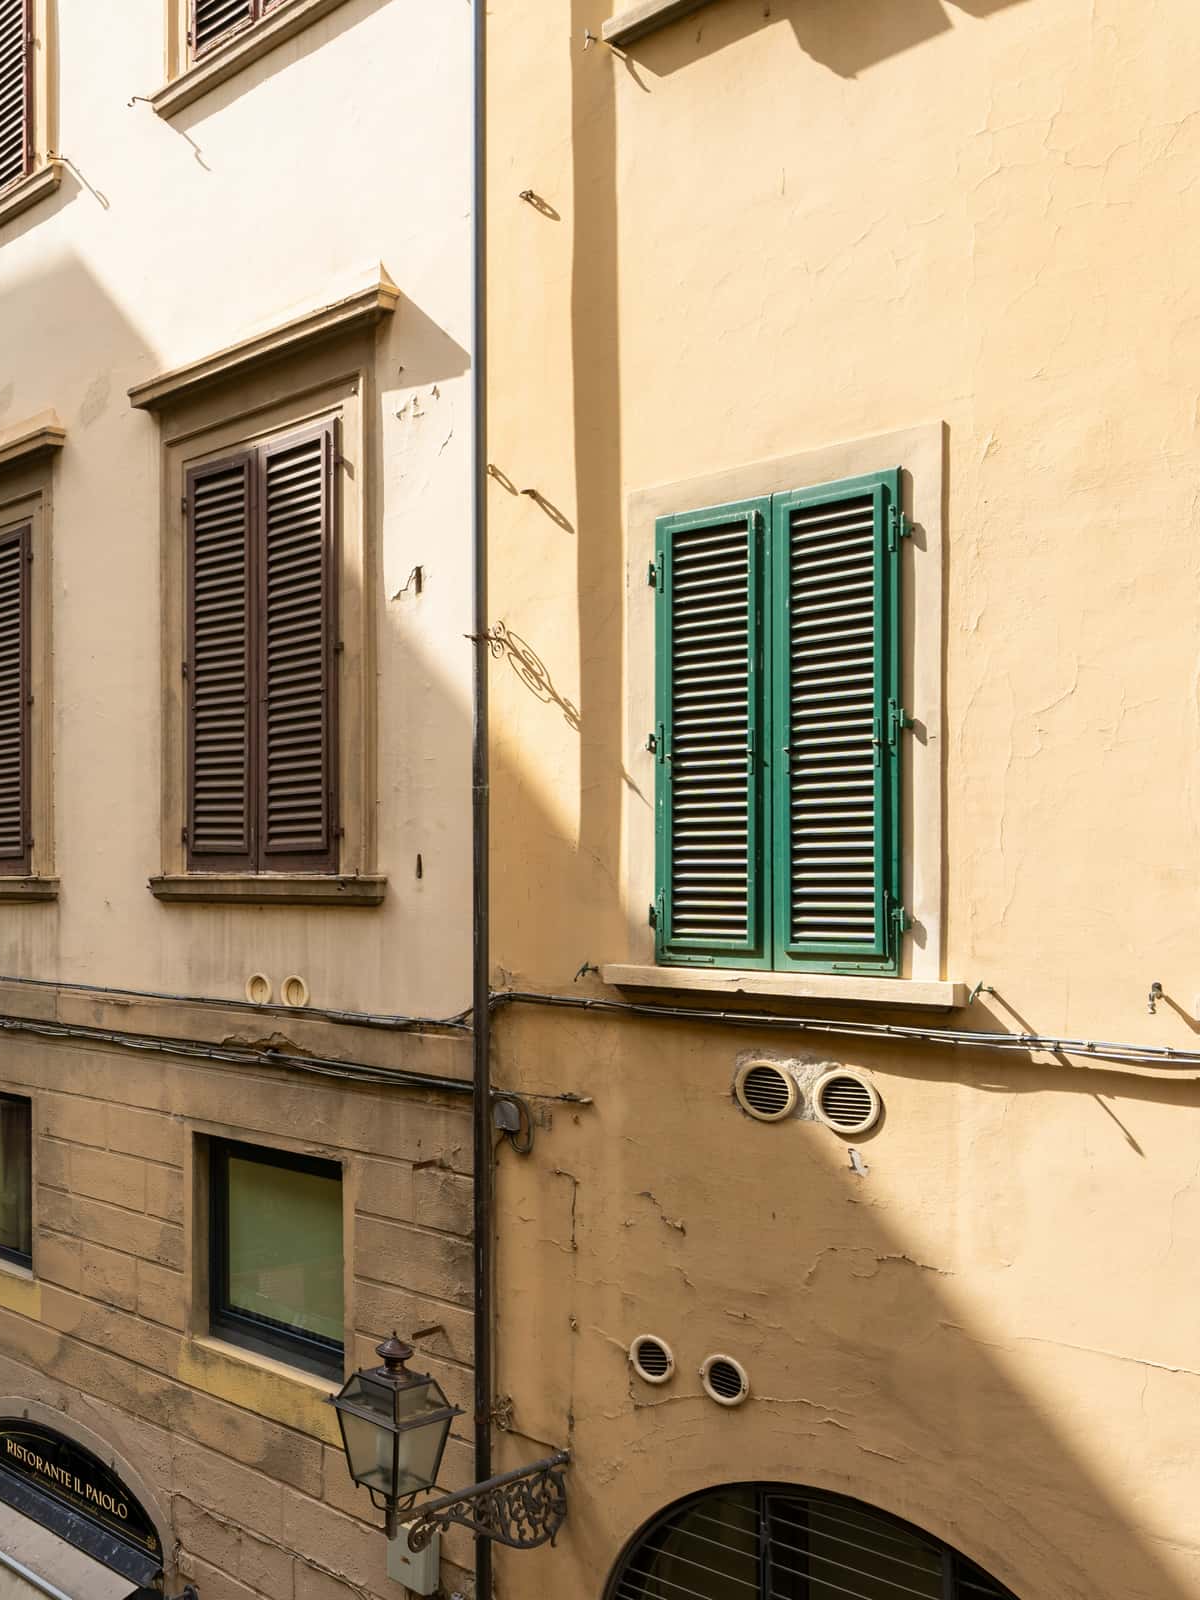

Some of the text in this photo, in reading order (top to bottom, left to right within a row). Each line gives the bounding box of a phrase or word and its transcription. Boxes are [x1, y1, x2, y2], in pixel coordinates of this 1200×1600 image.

[6, 1439, 72, 1489] RISTORANTE
[74, 1476, 84, 1495] IL
[86, 1483, 128, 1519] PAIOLO
